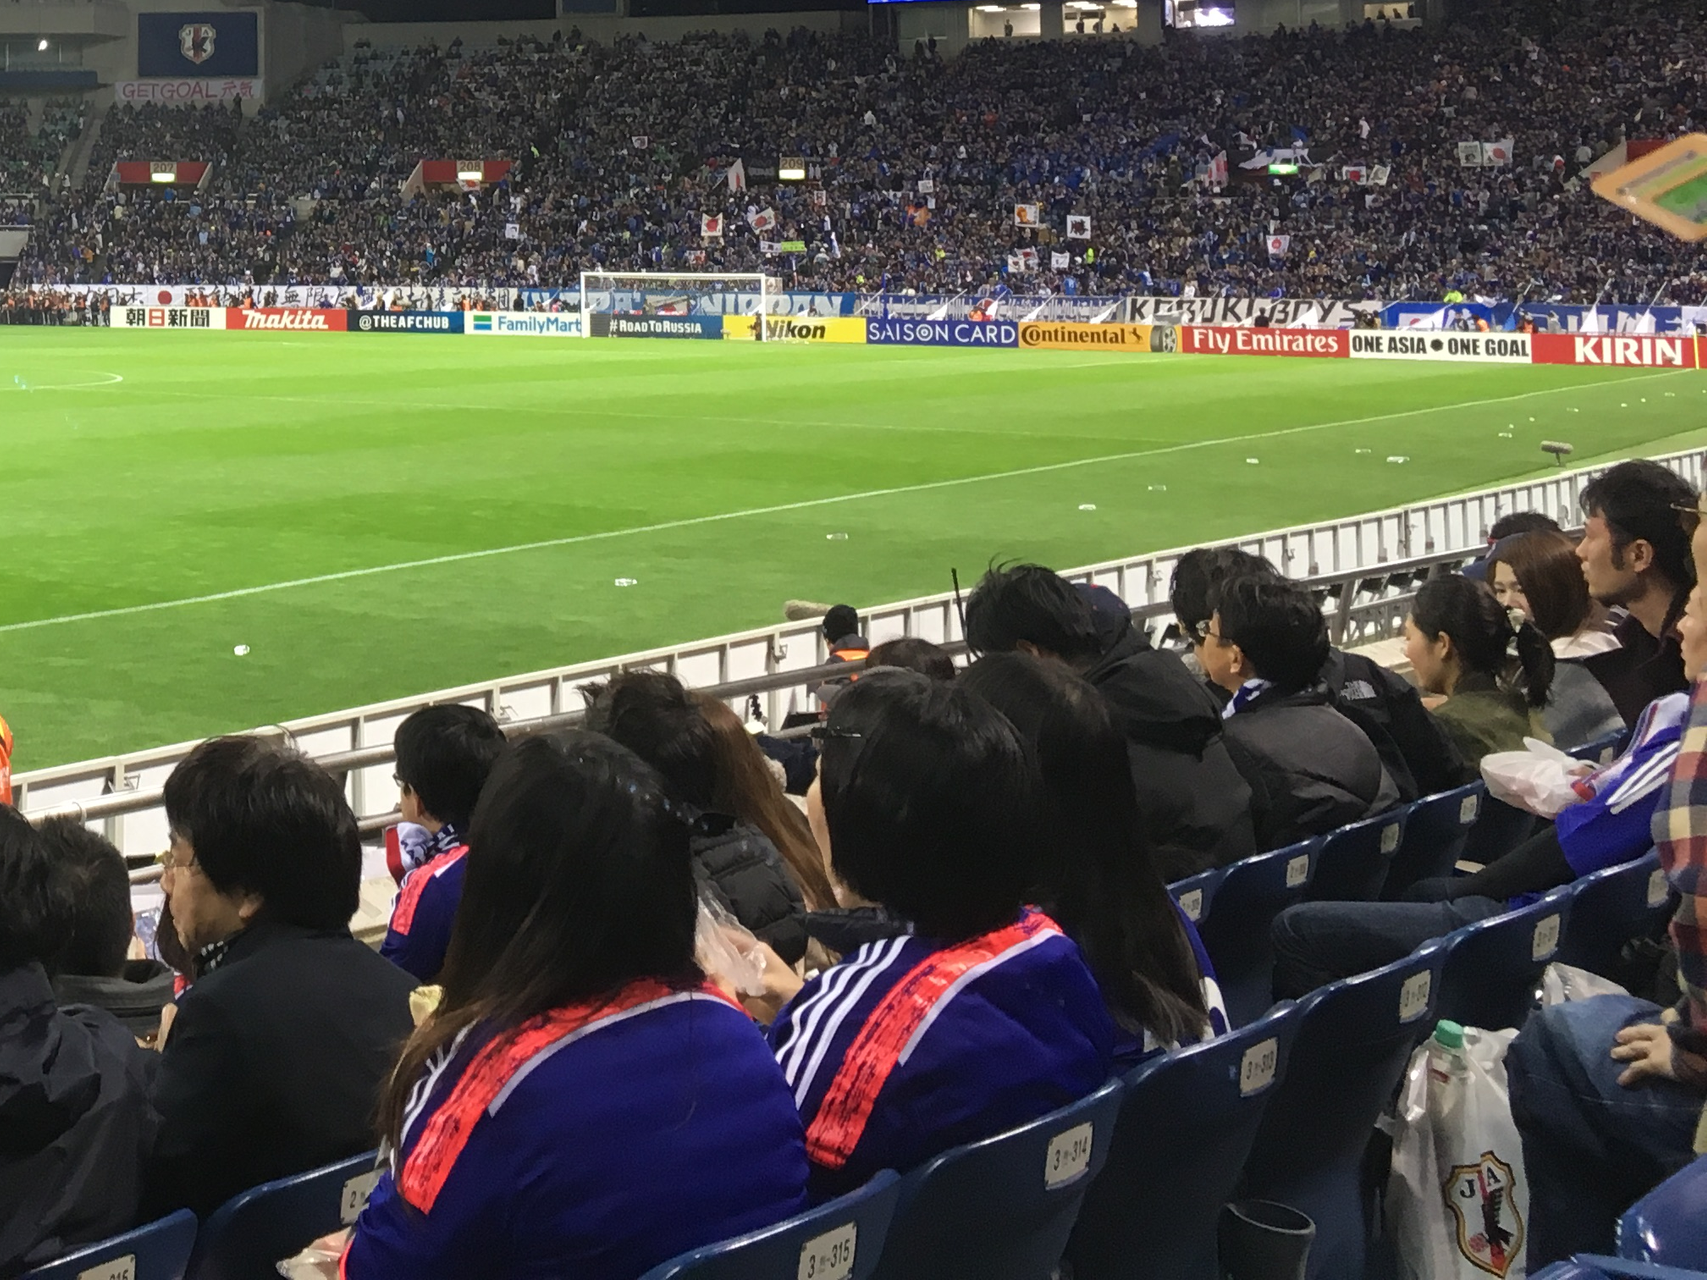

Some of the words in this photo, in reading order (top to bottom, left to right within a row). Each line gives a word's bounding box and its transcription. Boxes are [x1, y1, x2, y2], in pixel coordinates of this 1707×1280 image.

[459, 161, 481, 171] 208
[781, 158, 804, 169] 209
[126, 308, 210, 328] 朝日新聞
[359, 314, 450, 331] @THEAFCHUB
[497, 315, 581, 333] FamilyMart
[766, 319, 826, 340] Nikon
[869, 322, 949, 342] SAISON
[955, 325, 1016, 344] CARD
[1021, 324, 1126, 346] Continental
[1192, 328, 1231, 354] Fly
[1236, 329, 1338, 353] Emirates
[1352, 335, 1383, 353] ONE
[1387, 336, 1427, 354] ASIA
[1448, 337, 1480, 356] ONE
[1485, 338, 1530, 358] GOAL
[1574, 336, 1683, 366] KIRIN
[1460, 1179, 1476, 1198] J
[1486, 1166, 1501, 1187] A
